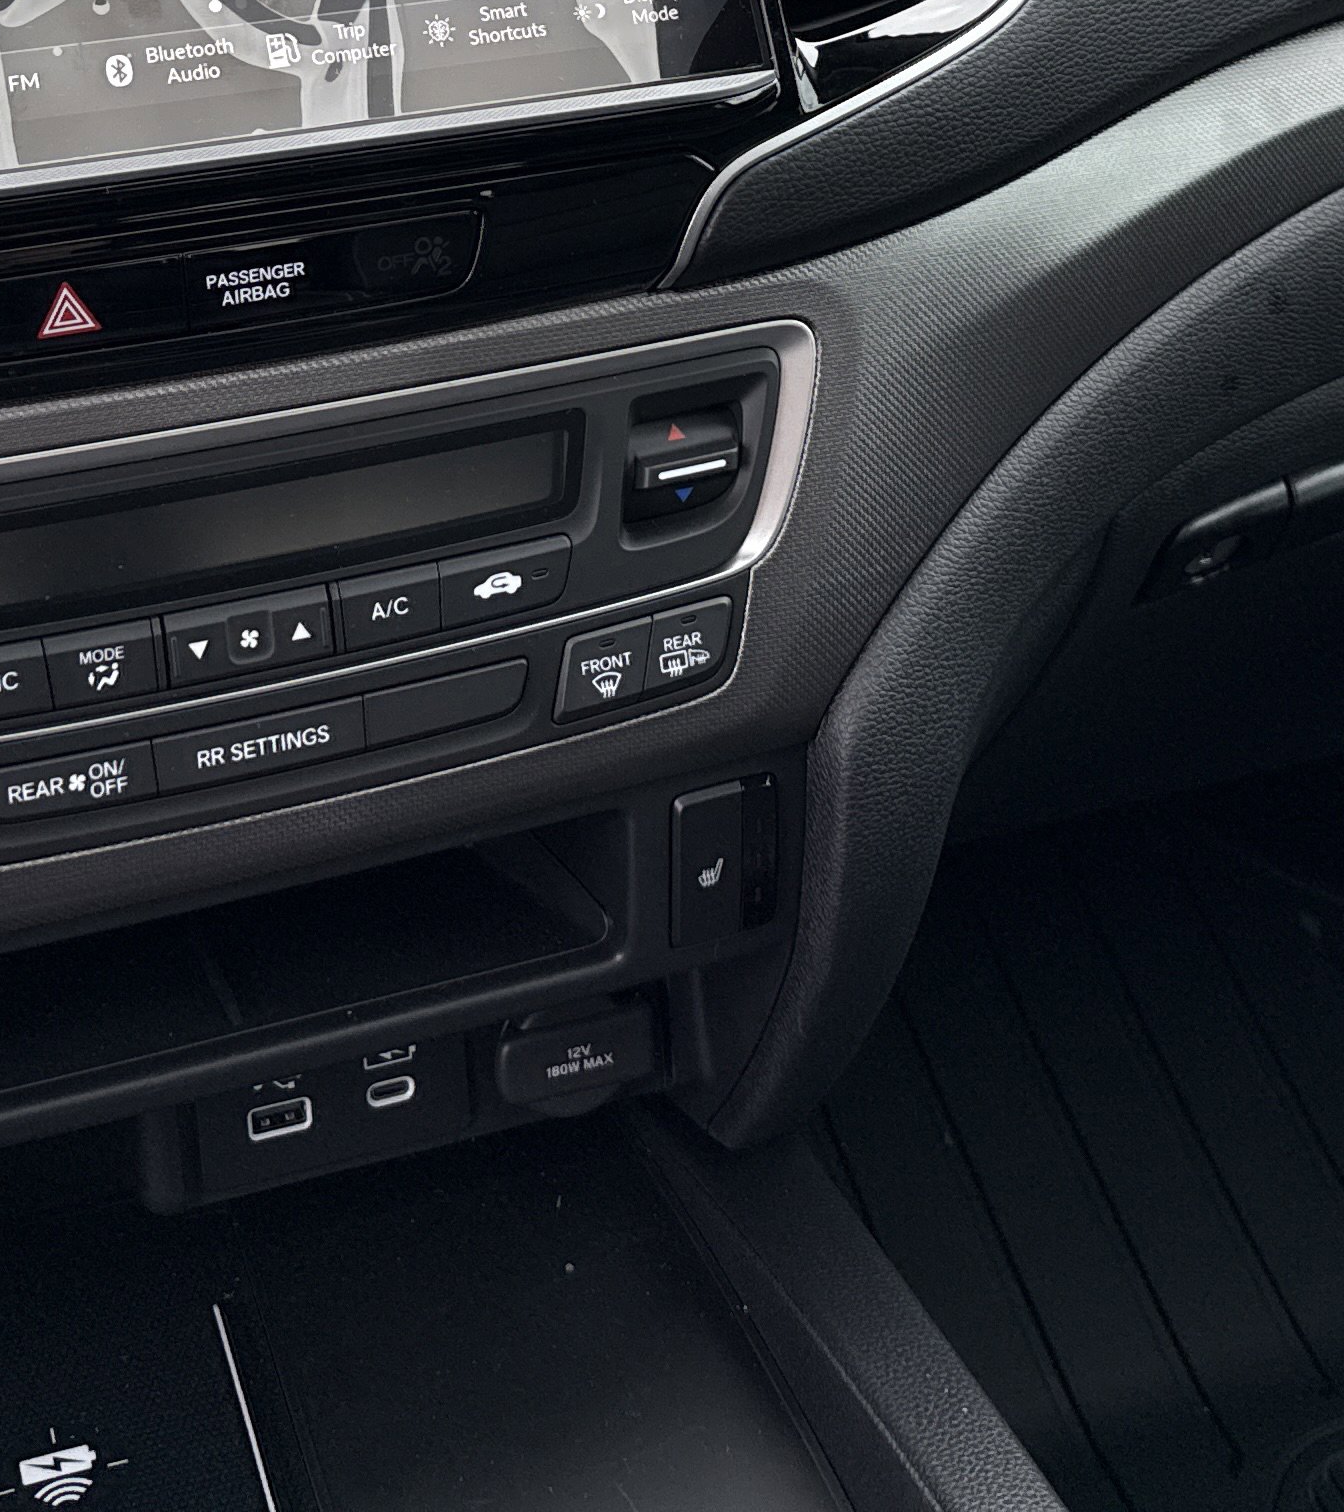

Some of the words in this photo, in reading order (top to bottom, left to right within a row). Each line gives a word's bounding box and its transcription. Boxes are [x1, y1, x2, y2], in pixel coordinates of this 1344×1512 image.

[478, 2, 528, 22] Smart
[631, 2, 680, 26] Mode
[333, 20, 366, 44] Trip
[468, 21, 548, 47] Shortcuts
[145, 37, 235, 64] Bluetooth
[311, 40, 398, 68] Computer
[7, 72, 41, 92] FM
[166, 62, 221, 84] Audio
[205, 260, 306, 291] PASSENGER
[221, 282, 291, 308] AIRBAG
[371, 596, 409, 622] A/C
[663, 631, 703, 652] REAR
[78, 645, 125, 666] MODE
[581, 651, 632, 676] FRONT
[197, 746, 226, 770] RR
[230, 725, 331, 763] SETTINGS
[7, 776, 65, 805] REAR
[90, 776, 129, 799] OFF
[567, 1043, 592, 1059] 12V
[546, 1060, 580, 1079] 180W
[582, 1051, 614, 1070] MAX
